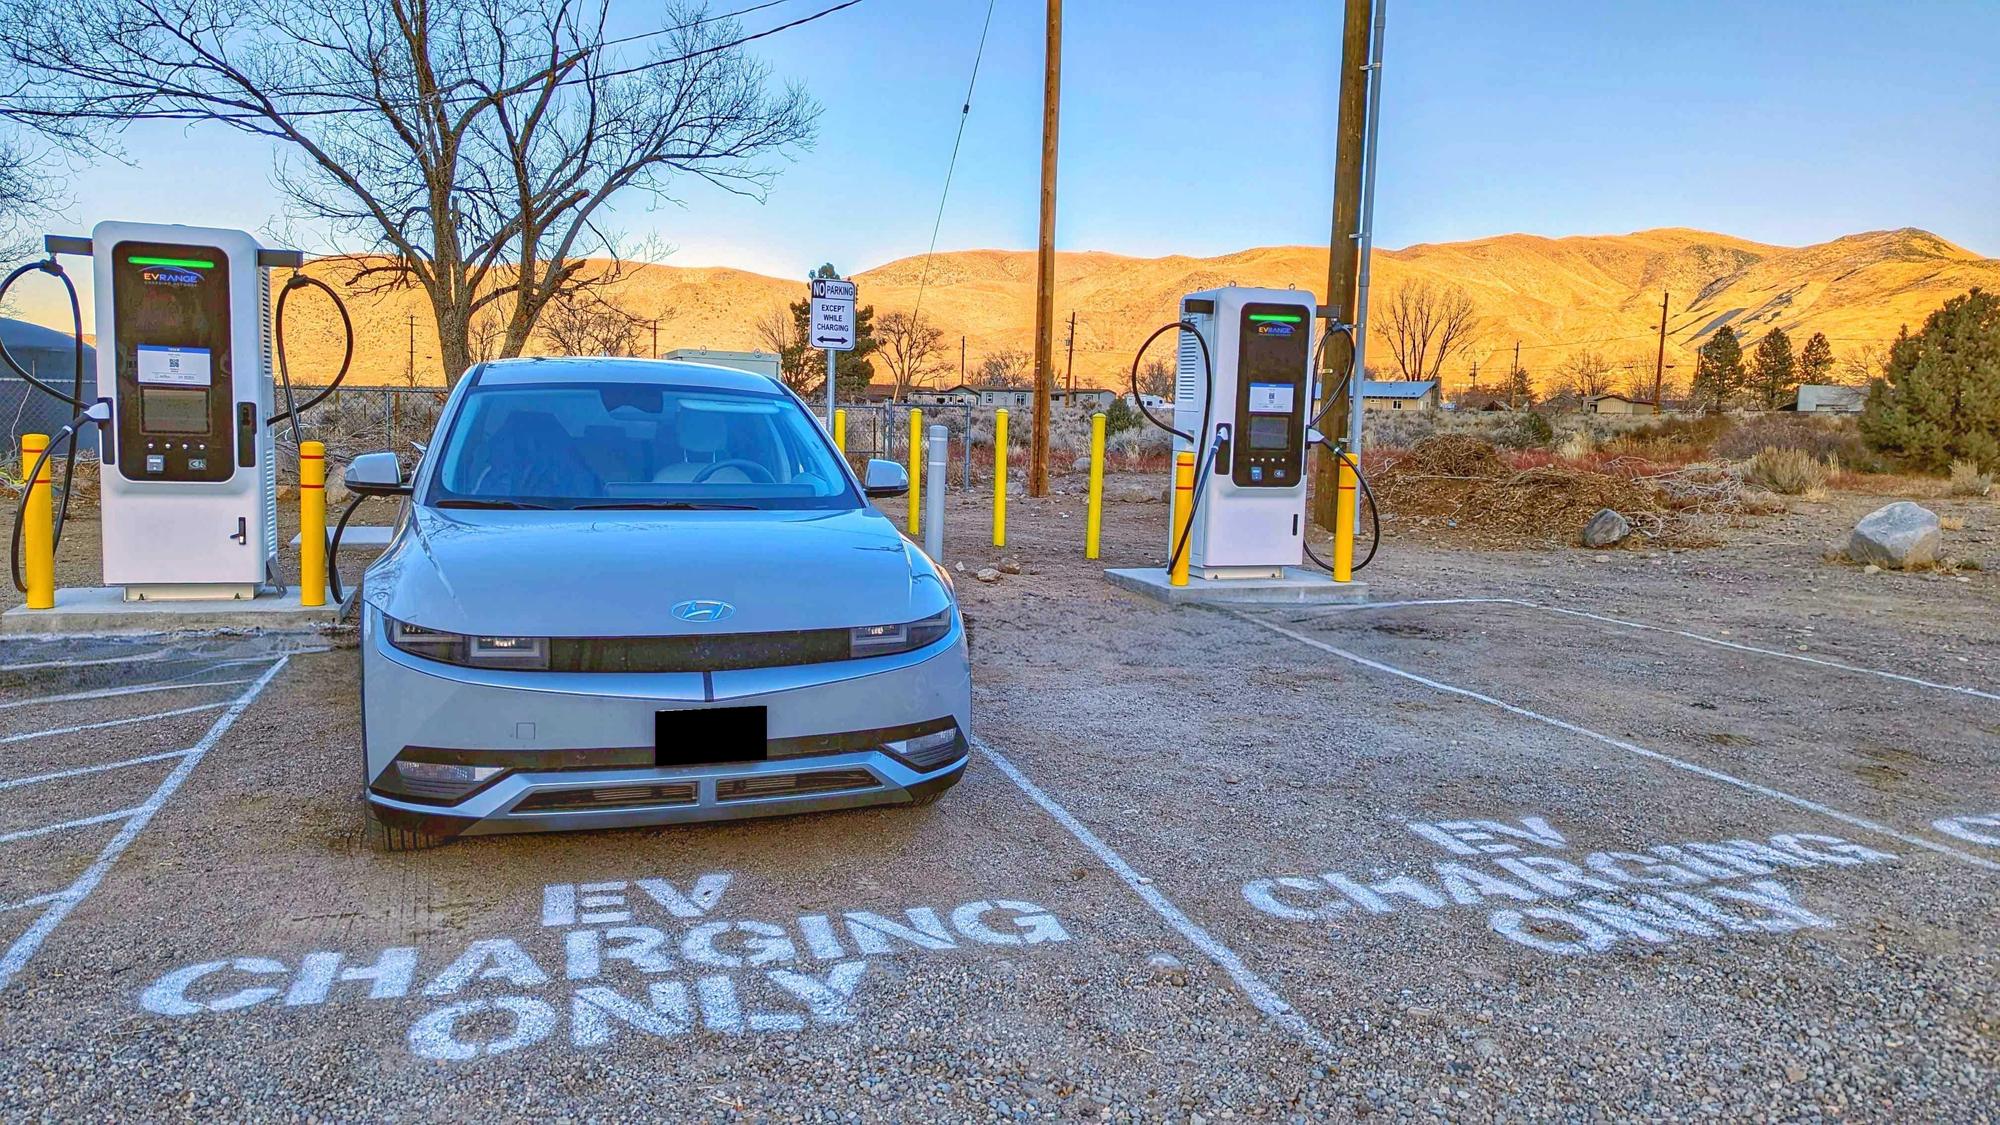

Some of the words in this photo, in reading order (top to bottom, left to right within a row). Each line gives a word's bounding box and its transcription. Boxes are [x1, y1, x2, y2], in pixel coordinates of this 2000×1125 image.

[144, 273, 198, 283] EVRANGE
[814, 282, 825, 296] NO
[827, 285, 853, 296] PARKING
[822, 304, 845, 312] EXCEPT
[823, 314, 843, 322] WHILE
[816, 323, 849, 332] CHARGING
[1406, 815, 1567, 855] EV
[1240, 833, 1900, 921] CHARGING
[542, 872, 734, 926] EV
[139, 899, 1072, 1017] CHARGING
[407, 959, 870, 1061] ONLY
